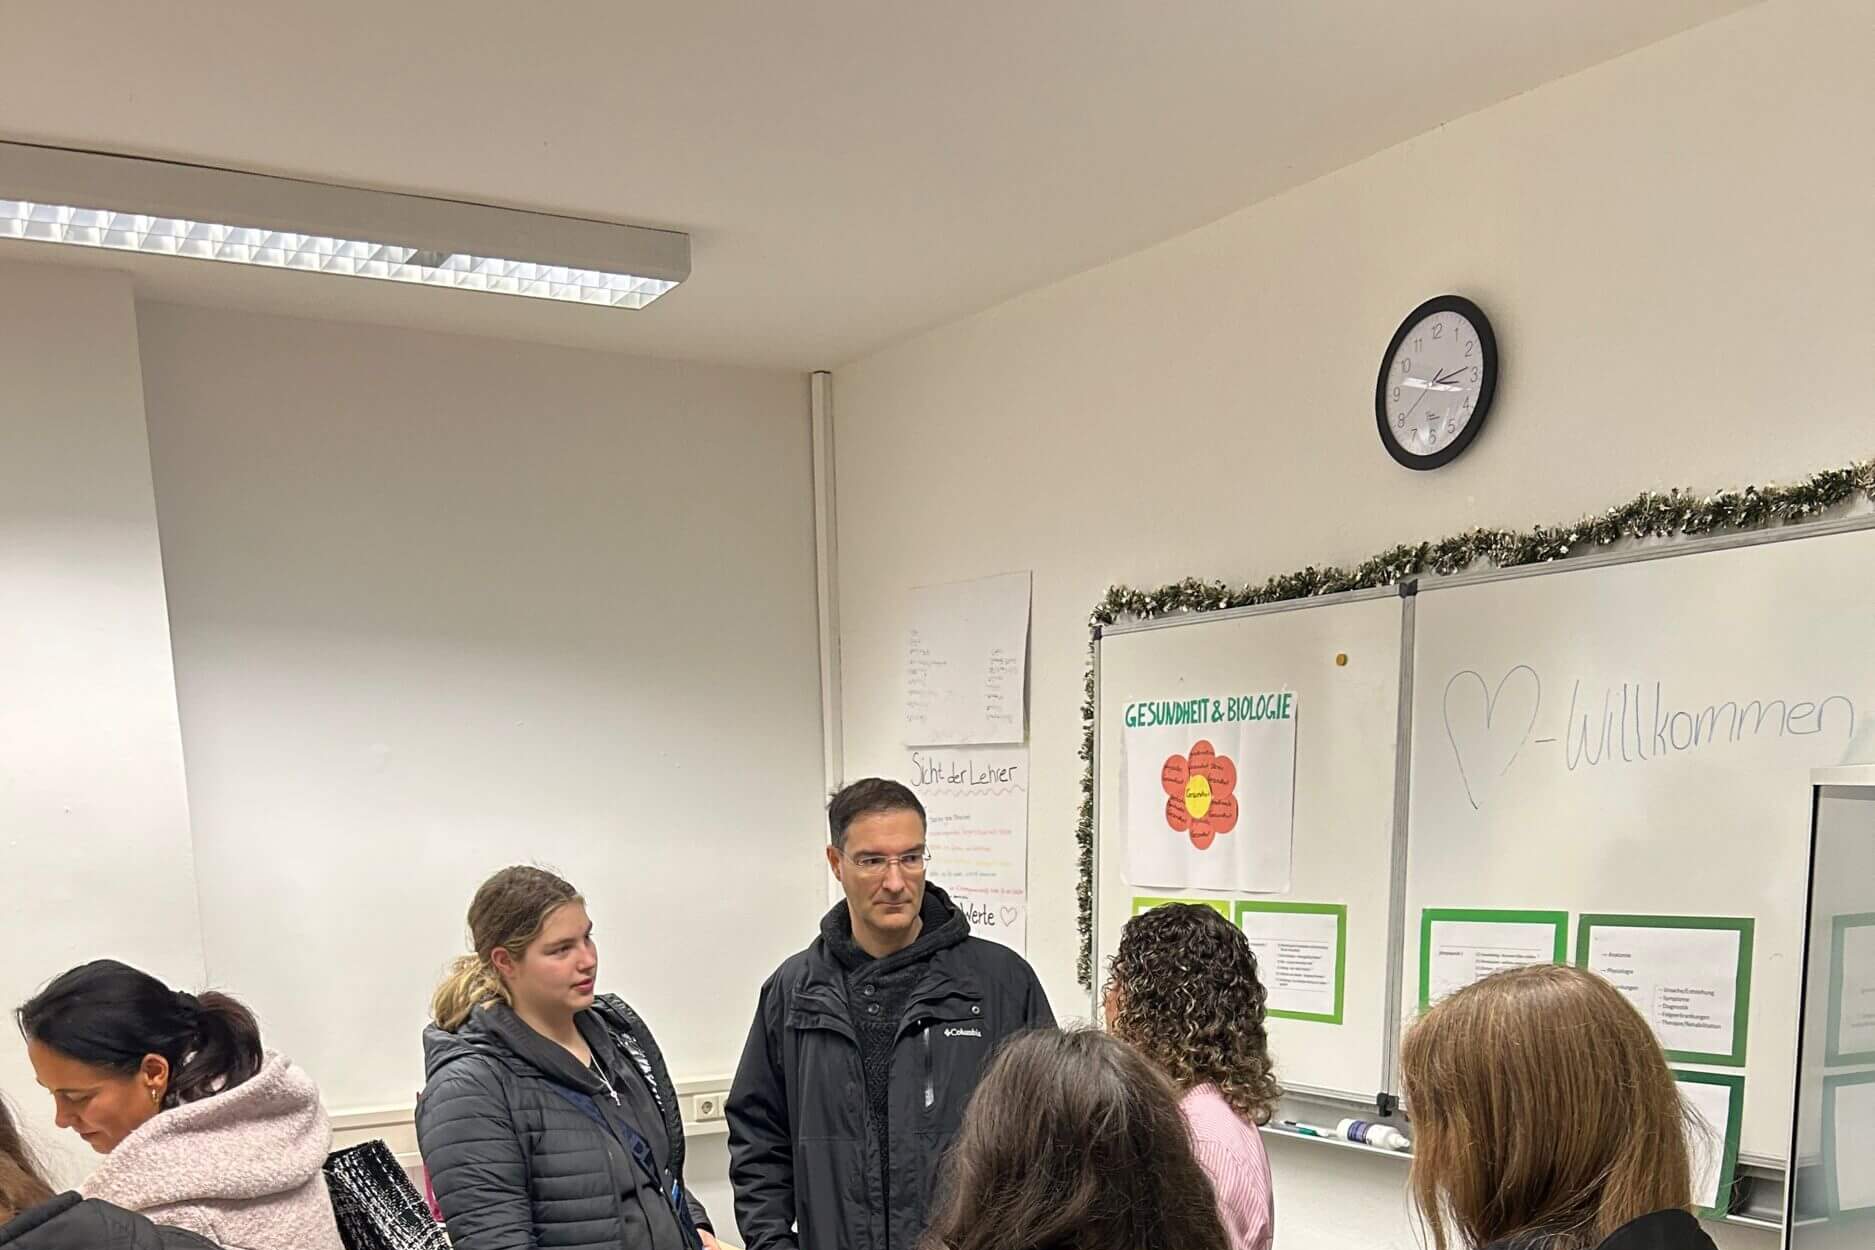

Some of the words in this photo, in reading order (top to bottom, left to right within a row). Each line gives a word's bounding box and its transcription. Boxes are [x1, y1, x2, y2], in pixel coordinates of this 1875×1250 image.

[1431, 323, 1443, 339] 12
[1453, 327, 1459, 342] 1
[1413, 338, 1423, 353] 11
[1464, 340, 1474, 357] 2
[1401, 358, 1411, 373] 10
[1471, 366, 1479, 383] 3
[1393, 387, 1401, 402] 9
[1462, 396, 1470, 410] 4
[1397, 413, 1406, 428] 8
[1447, 418, 1456, 434] 5
[1411, 428, 1418, 441] 7
[1125, 698, 1210, 728] GESUNDHEIT
[1212, 700, 1225, 723] &
[1228, 693, 1293, 722] BIOLOGIE
[911, 752, 945, 787] Sicht
[947, 761, 967, 784] der
[969, 760, 1018, 786] Lehrer
